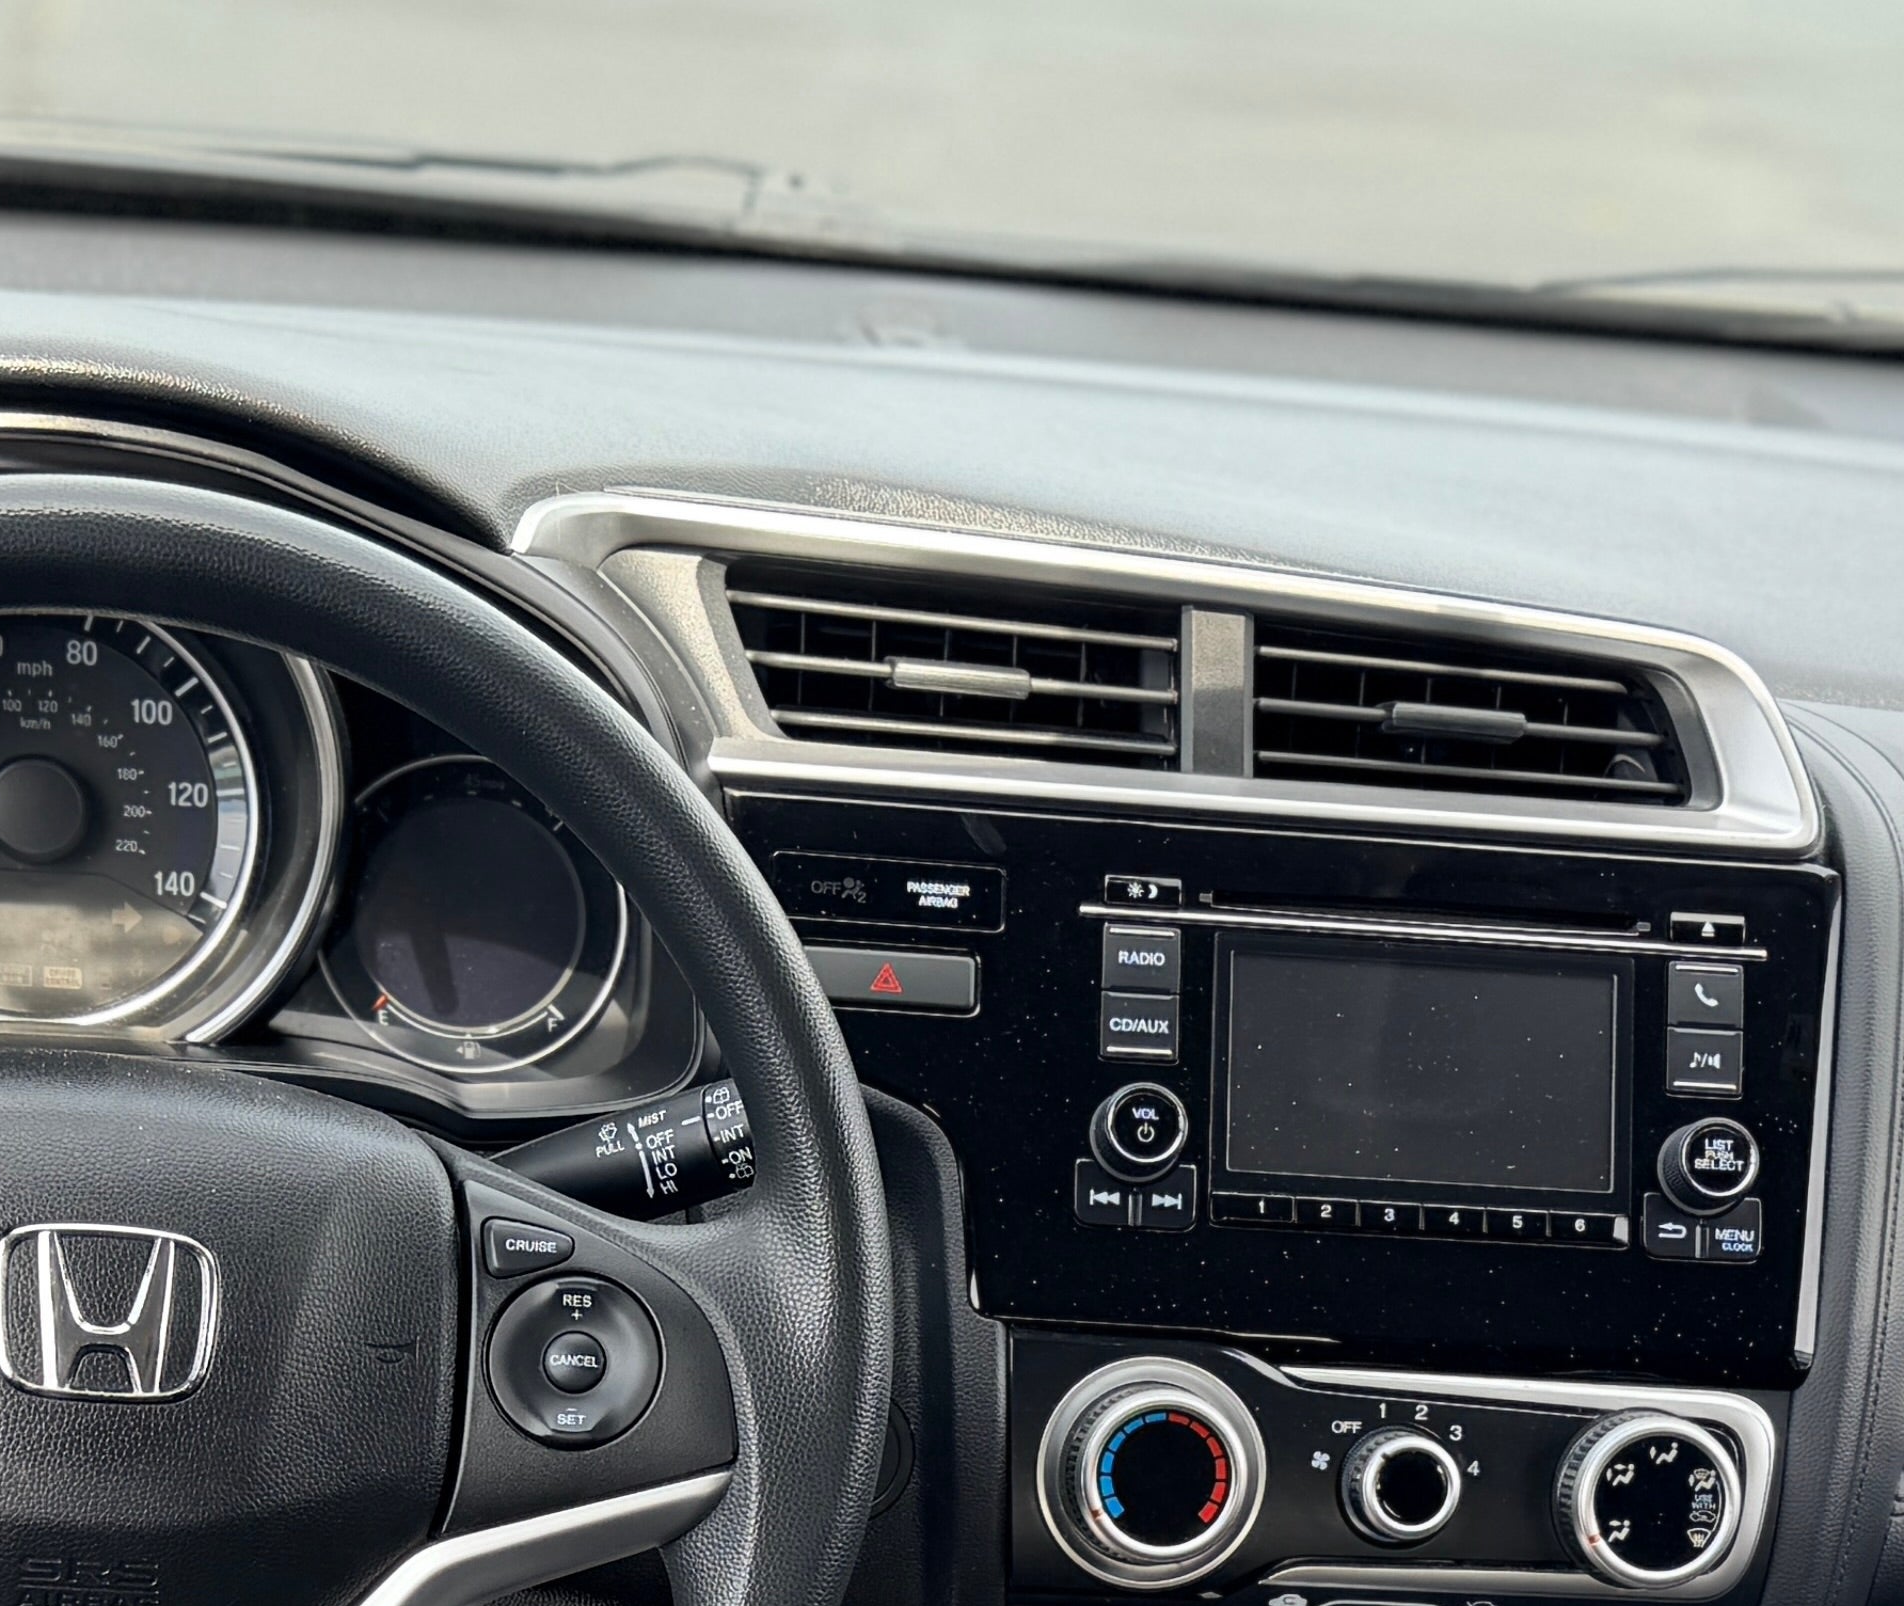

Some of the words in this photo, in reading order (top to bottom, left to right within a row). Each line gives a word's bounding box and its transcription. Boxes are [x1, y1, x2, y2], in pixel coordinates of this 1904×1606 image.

[66, 640, 97, 666] 80
[17, 660, 53, 678] mph
[2, 700, 22, 712] 100
[38, 700, 58, 713] 120
[130, 699, 173, 725] 100
[20, 717, 51, 730] km/h
[71, 713, 92, 727] 140
[98, 735, 117, 748] 160
[117, 768, 137, 781] 180
[168, 782, 208, 808] 120
[123, 805, 145, 818] 200
[115, 839, 138, 852] 220
[154, 871, 195, 896] 140
[811, 880, 841, 895] OFF
[906, 881, 971, 897] PASSENGER
[918, 895, 958, 909] AIRBAG
[1118, 951, 1165, 966] RADIO
[377, 1012, 390, 1026] E
[546, 1018, 558, 1033] F
[1109, 1018, 1169, 1034] CD/AUX
[715, 1100, 744, 1120] OFF
[1132, 1107, 1159, 1120] VOL
[646, 1128, 674, 1149] OFF
[720, 1124, 744, 1143] INT
[596, 1140, 625, 1158] PULL
[1705, 1138, 1734, 1151] LIST
[651, 1145, 676, 1165] INT
[728, 1146, 753, 1165] ON
[656, 1163, 678, 1180] LO
[1694, 1159, 1744, 1172] SELECT
[659, 1179, 679, 1194] HI
[1258, 1201, 1265, 1214] 1
[1320, 1205, 1332, 1219] 2
[1384, 1208, 1395, 1222] 3
[1448, 1212, 1460, 1226] 4
[1512, 1216, 1523, 1229] 5
[1575, 1219, 1586, 1233] 6
[1715, 1228, 1755, 1242] MENU
[505, 1239, 557, 1254] CRUISE
[1721, 1242, 1753, 1252] CLOCK
[562, 1294, 592, 1308] RES
[549, 1354, 598, 1367] CANCEL
[1378, 1402, 1387, 1419] 1
[1414, 1404, 1429, 1421] 2
[556, 1413, 586, 1425] SET
[1331, 1420, 1363, 1434] OFF
[1449, 1425, 1462, 1441] 3
[1467, 1460, 1480, 1476] 4
